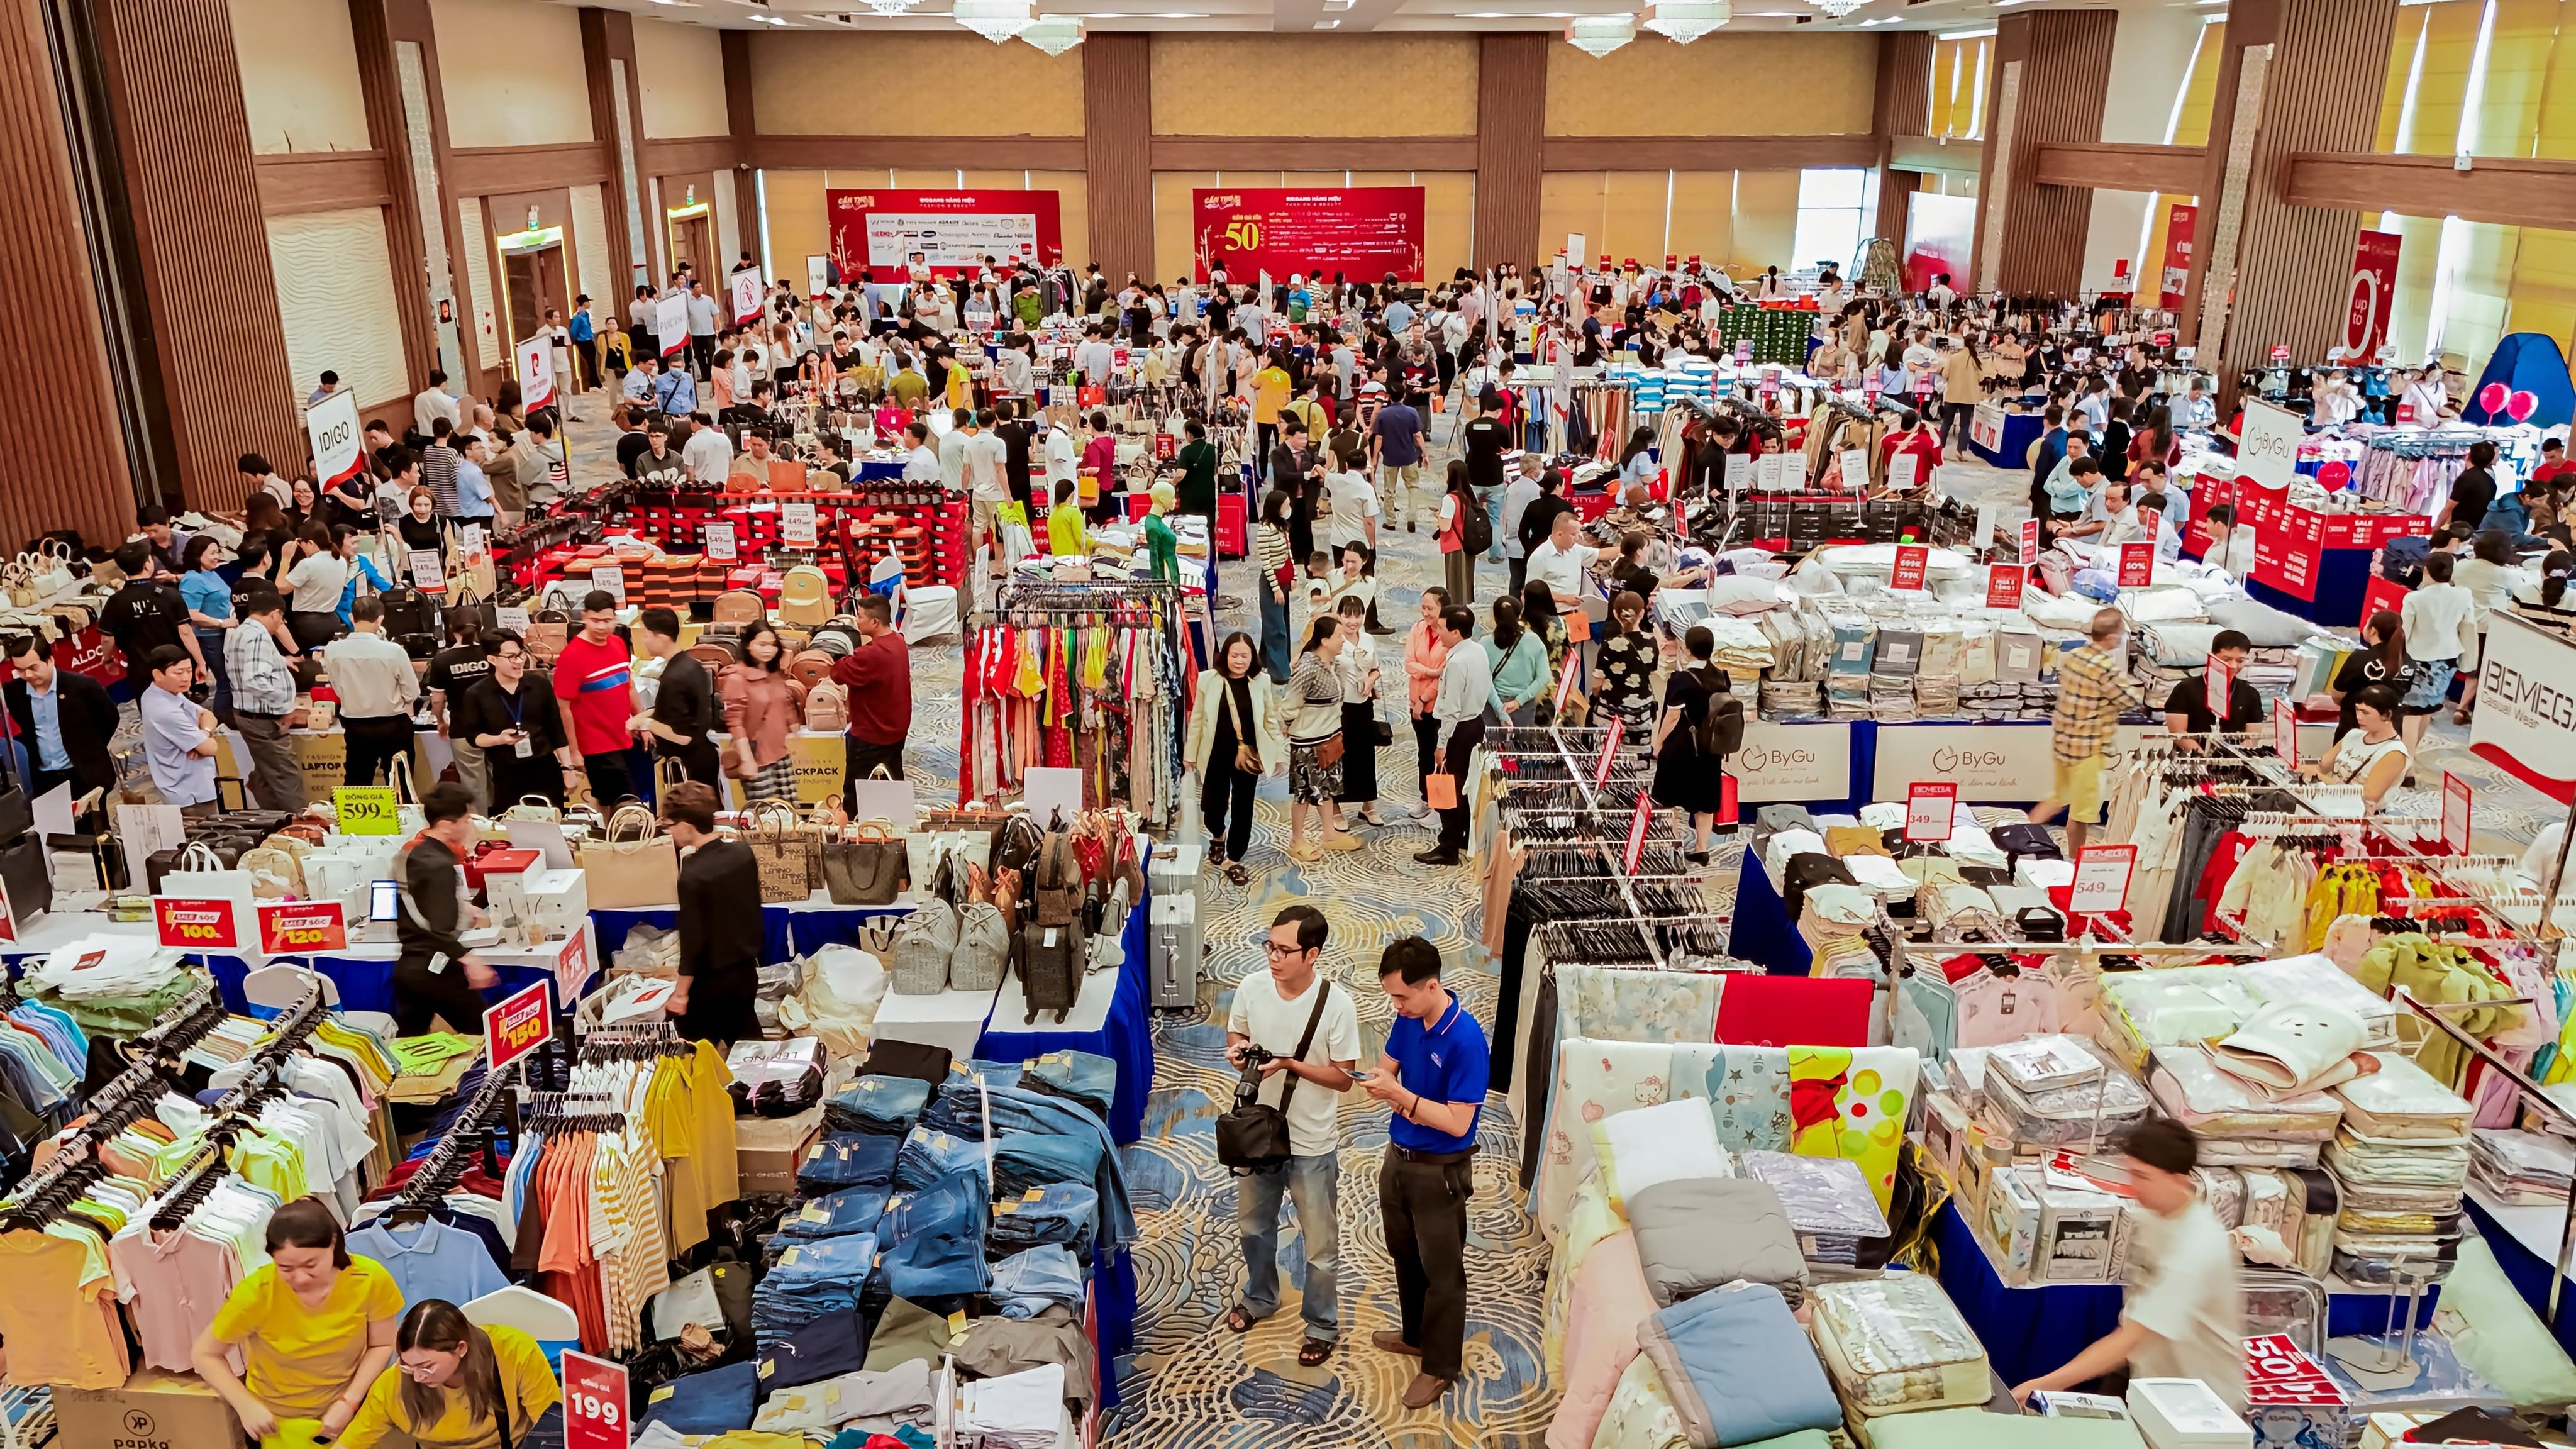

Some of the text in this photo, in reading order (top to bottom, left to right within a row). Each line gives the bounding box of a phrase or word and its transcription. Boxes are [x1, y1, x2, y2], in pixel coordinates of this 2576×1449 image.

[2355, 299, 2367, 313] up
[2353, 314, 2362, 325] to
[319, 421, 350, 453] IDIGO
[2262, 432, 2290, 458] ByGu
[450, 660, 489, 675] IDIGO
[2484, 658, 2576, 733] BEMEG
[2481, 691, 2540, 730] Casual Wear
[302, 762, 341, 771] LAPTOP
[1772, 749, 1815, 767] ByGu
[1962, 752, 2006, 769] ByGu
[343, 802, 380, 820] 599
[1909, 815, 1930, 823] 349
[2075, 882, 2106, 894] 549
[180, 924, 217, 938] 100
[286, 930, 323, 943] 120
[508, 1018, 541, 1049] 150
[571, 1392, 619, 1426] 199
